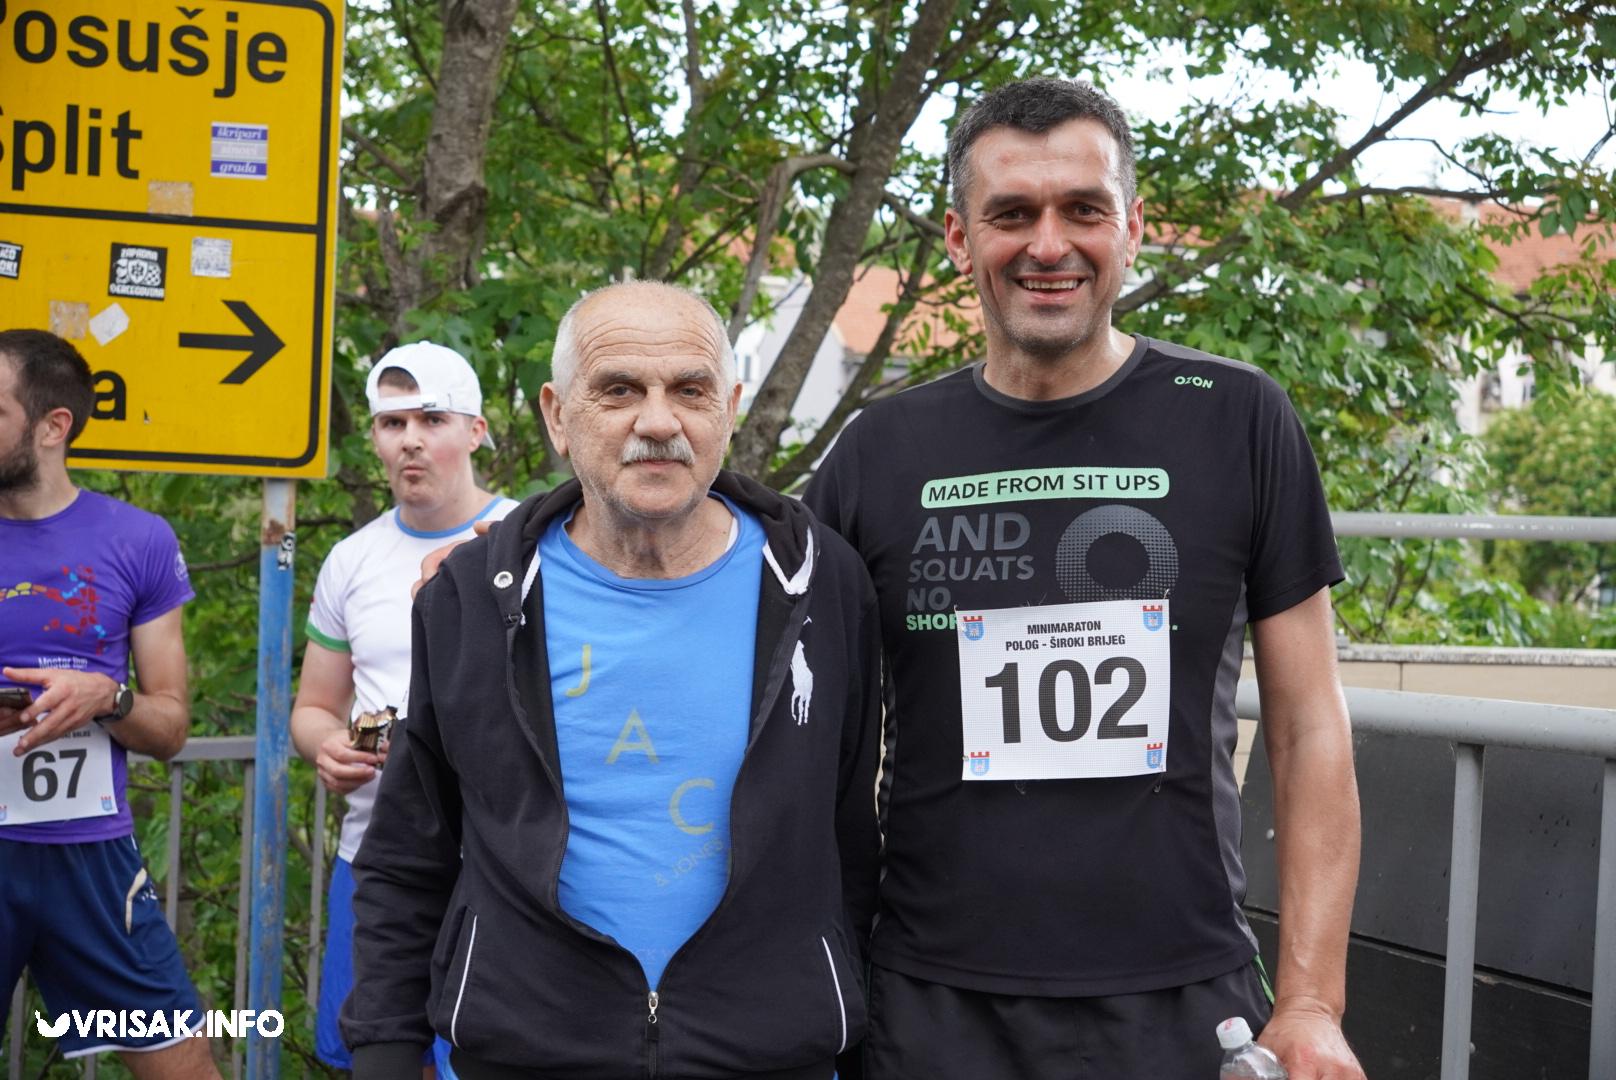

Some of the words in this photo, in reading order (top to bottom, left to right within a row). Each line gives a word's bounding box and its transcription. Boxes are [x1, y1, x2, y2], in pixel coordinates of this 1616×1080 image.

[0, 103, 143, 191] plit
[219, 161, 258, 175] grada
[928, 481, 989, 502] MADE
[996, 474, 1065, 497] FROM
[1073, 473, 1109, 491] SIT
[1115, 474, 1161, 492] UPS
[911, 511, 1032, 554] AND
[906, 555, 1035, 583] SQUATS
[906, 586, 951, 611] NO
[1027, 620, 1102, 635] MINIMARATON
[1005, 639, 1039, 652] POLOG
[1050, 635, 1085, 649] ŠIROKI
[1088, 635, 1126, 648] BRIJEG
[985, 656, 1149, 744] 102
[22, 748, 88, 802] 67
